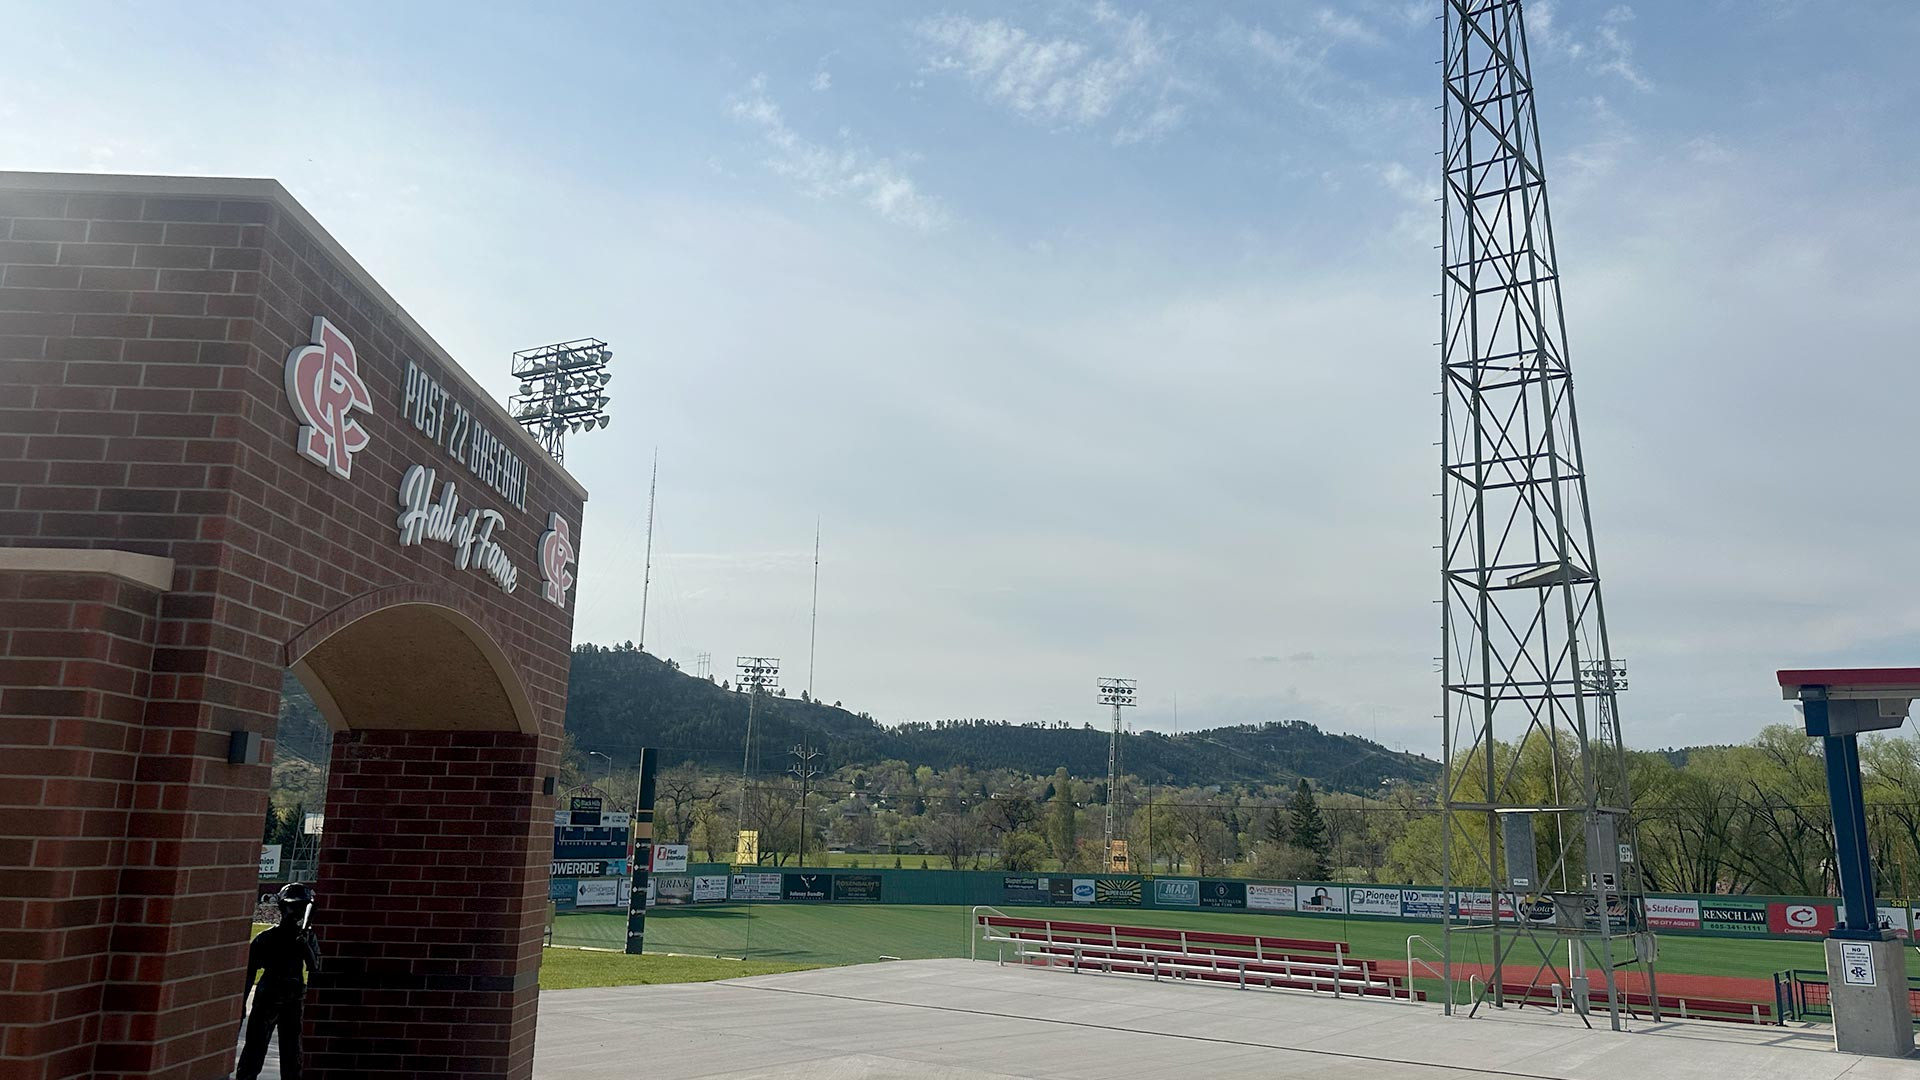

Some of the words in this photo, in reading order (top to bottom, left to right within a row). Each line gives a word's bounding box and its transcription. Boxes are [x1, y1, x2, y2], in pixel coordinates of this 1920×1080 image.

[402, 359, 449, 446] POST
[449, 402, 470, 465] 22
[470, 419, 528, 514] BASEBALL
[397, 464, 458, 546] Hall
[453, 508, 481, 570] of
[471, 508, 519, 594] Fame
[552, 862, 600, 875] OWERADE
[1165, 884, 1188, 895] MAC
[1366, 890, 1399, 900] Pioneer
[1703, 909, 1742, 921] RENSCH
[1743, 911, 1765, 922] LAW
